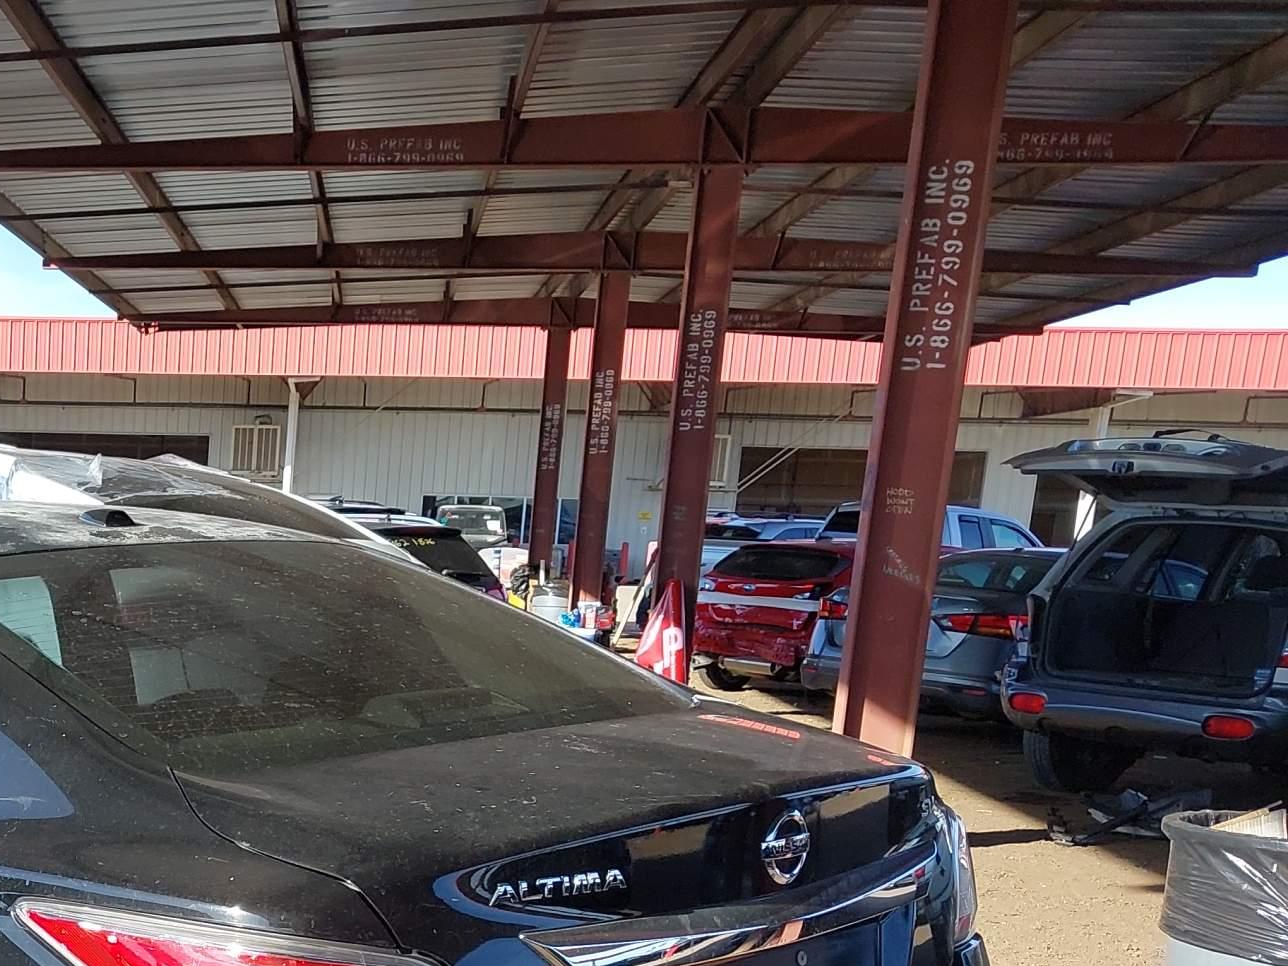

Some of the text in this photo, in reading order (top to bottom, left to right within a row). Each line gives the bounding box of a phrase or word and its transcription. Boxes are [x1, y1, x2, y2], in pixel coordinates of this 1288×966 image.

[346, 137, 373, 151] U.S.
[1020, 131, 1081, 146] PREFAB
[900, 158, 951, 371] U.S. PREFAB INC.
[925, 159, 976, 369] 1-866-799-0969
[678, 308, 704, 431] U.S. PREFAB INC.
[692, 309, 718, 430] 1-866-799-0969
[488, 868, 628, 907] ALTIMA
